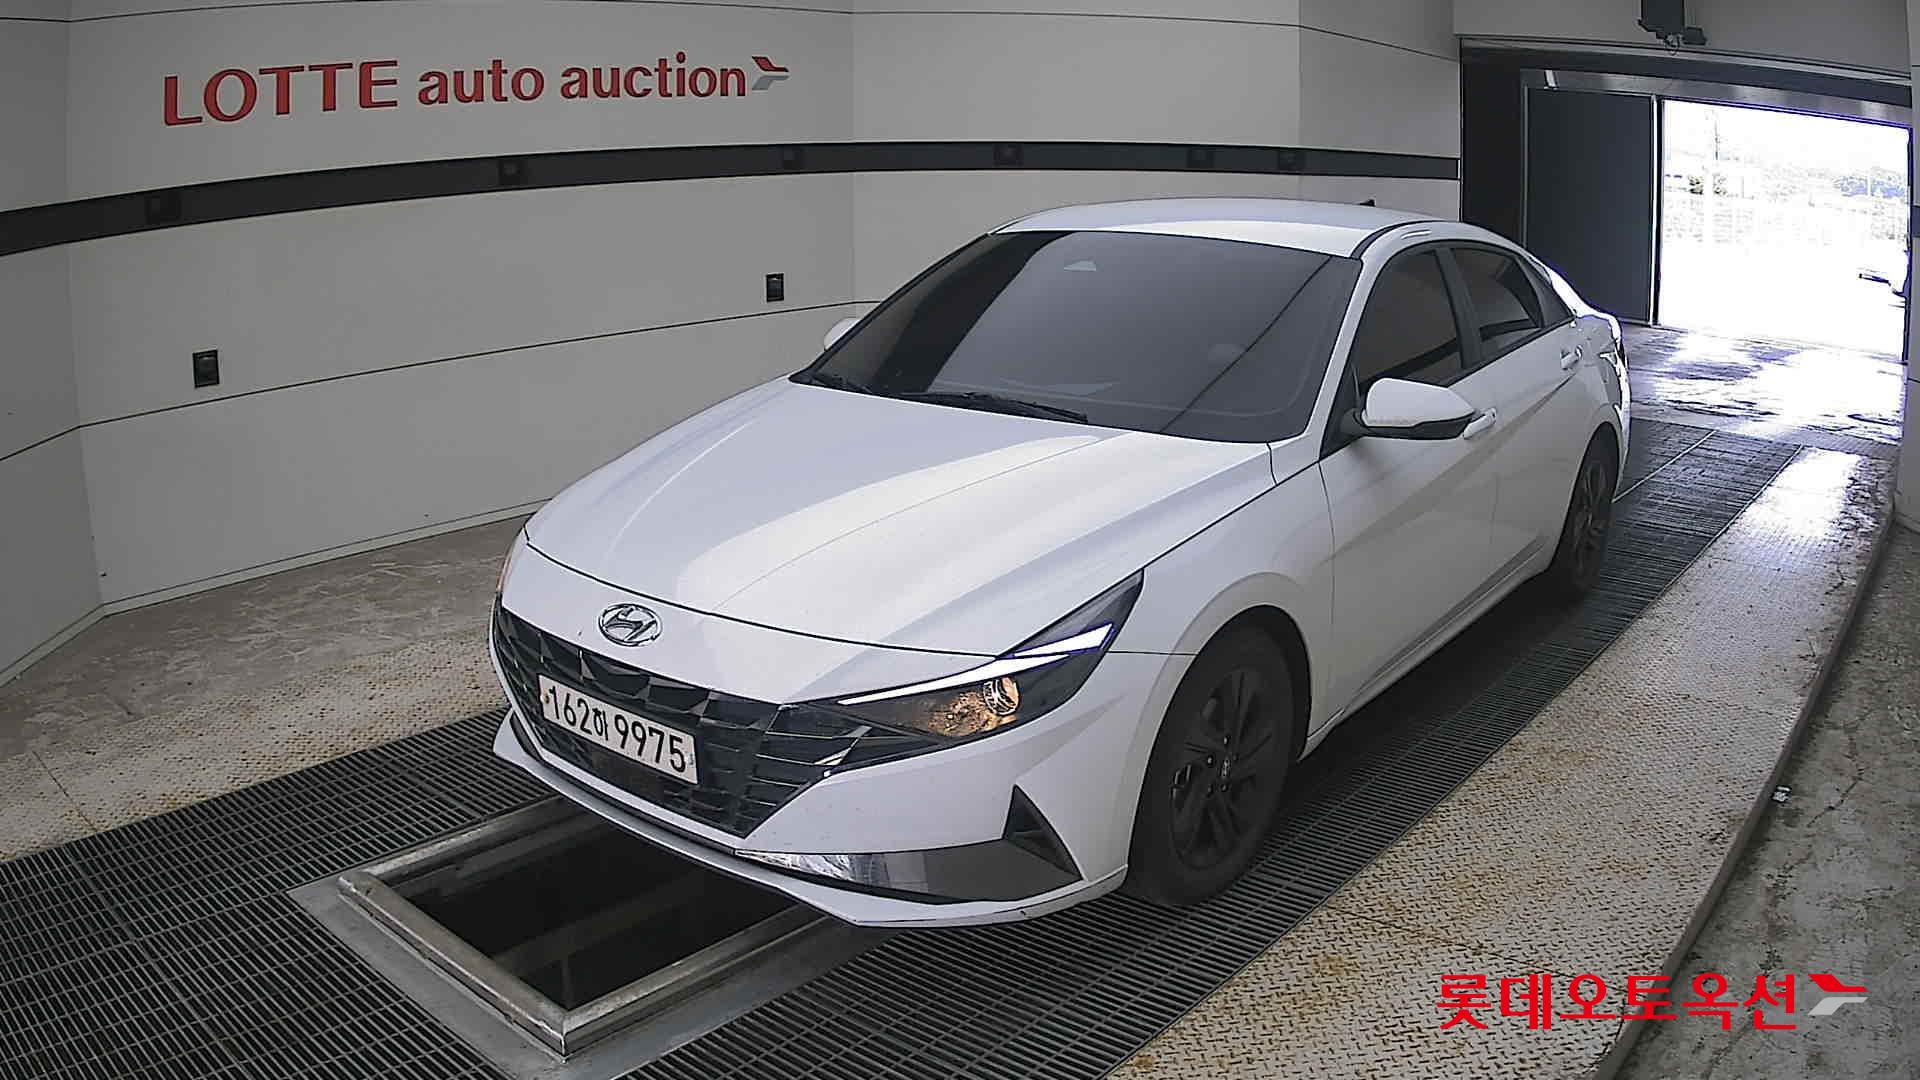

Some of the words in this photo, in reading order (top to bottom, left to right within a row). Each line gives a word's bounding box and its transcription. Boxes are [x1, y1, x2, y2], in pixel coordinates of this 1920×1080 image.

[164, 60, 398, 126] LOTTE
[418, 59, 545, 105] auto
[560, 51, 747, 99] auction
[614, 714, 686, 773] 9975
